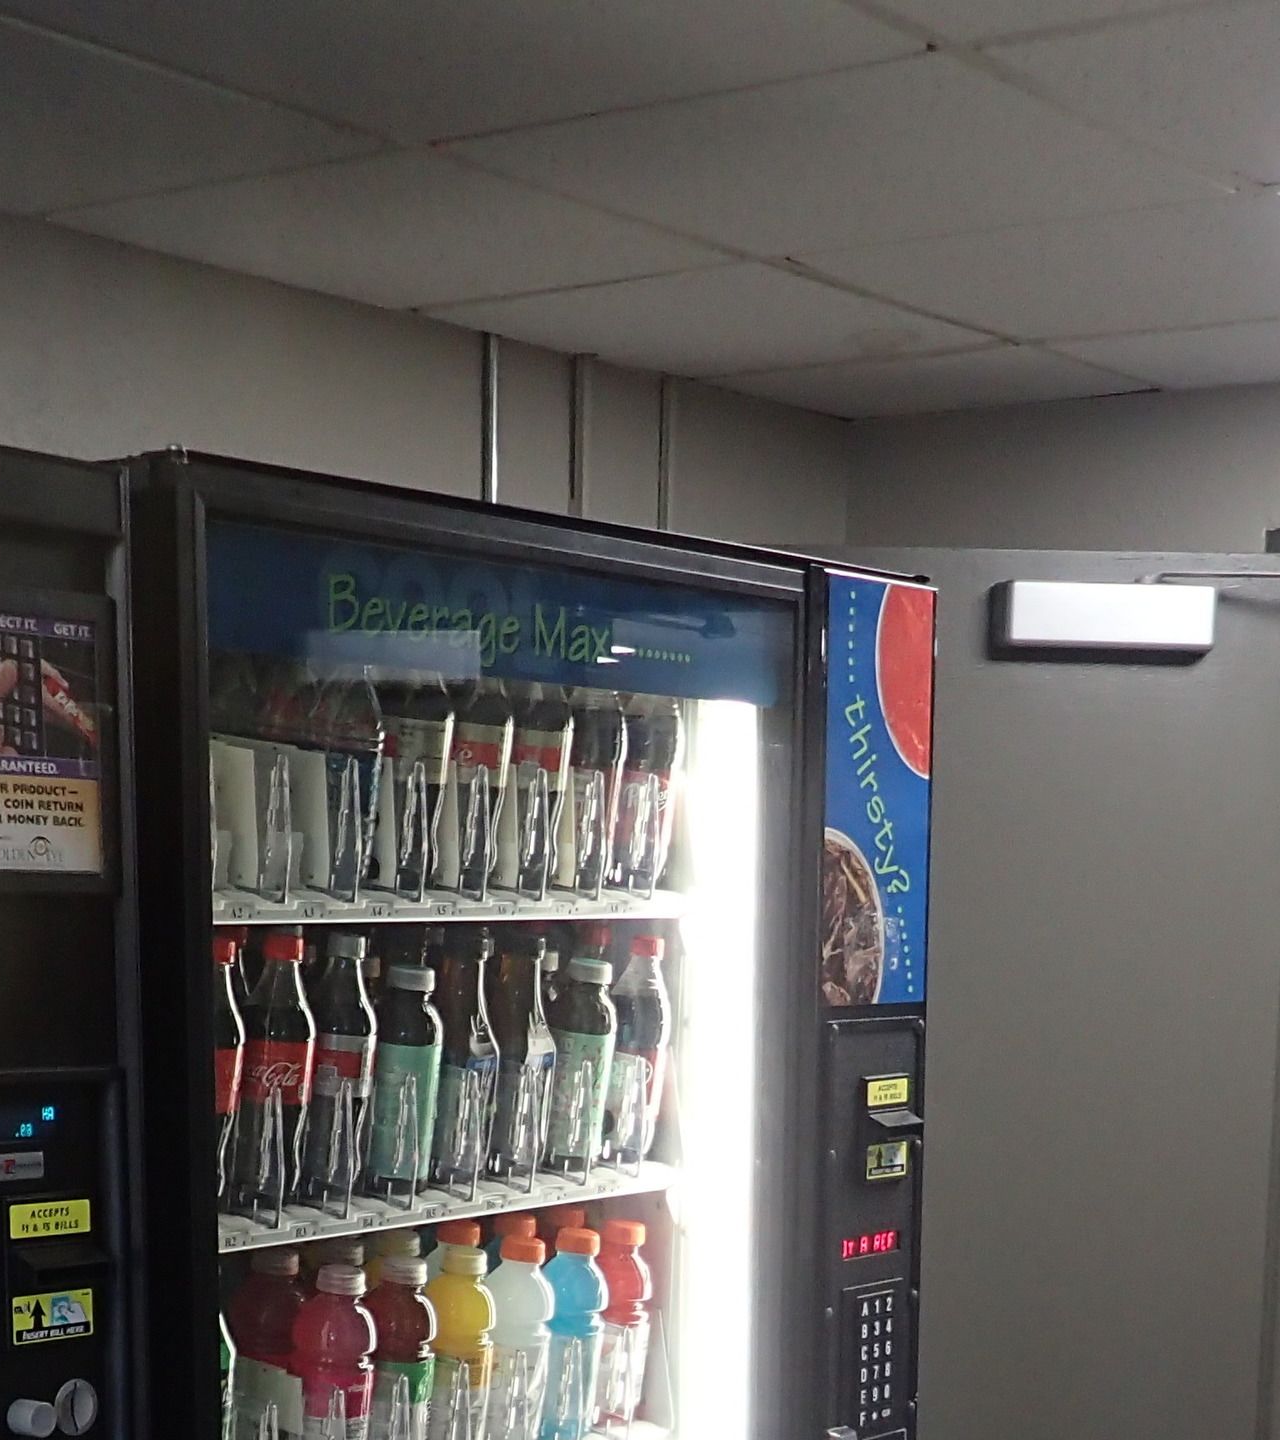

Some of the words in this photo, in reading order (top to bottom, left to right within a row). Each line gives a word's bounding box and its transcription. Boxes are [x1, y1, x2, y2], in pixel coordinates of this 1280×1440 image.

[326, 572, 521, 667] Beverage
[532, 603, 615, 664] Max
[53, 622, 77, 637] GET
[844, 692, 911, 895] thirsty?
[3, 798, 35, 812] COIN
[37, 800, 84, 813] RETURN
[6, 814, 49, 827] MONEY
[29, 1206, 70, 1219] ACCEPTS
[54, 1219, 80, 1231] BILLS
